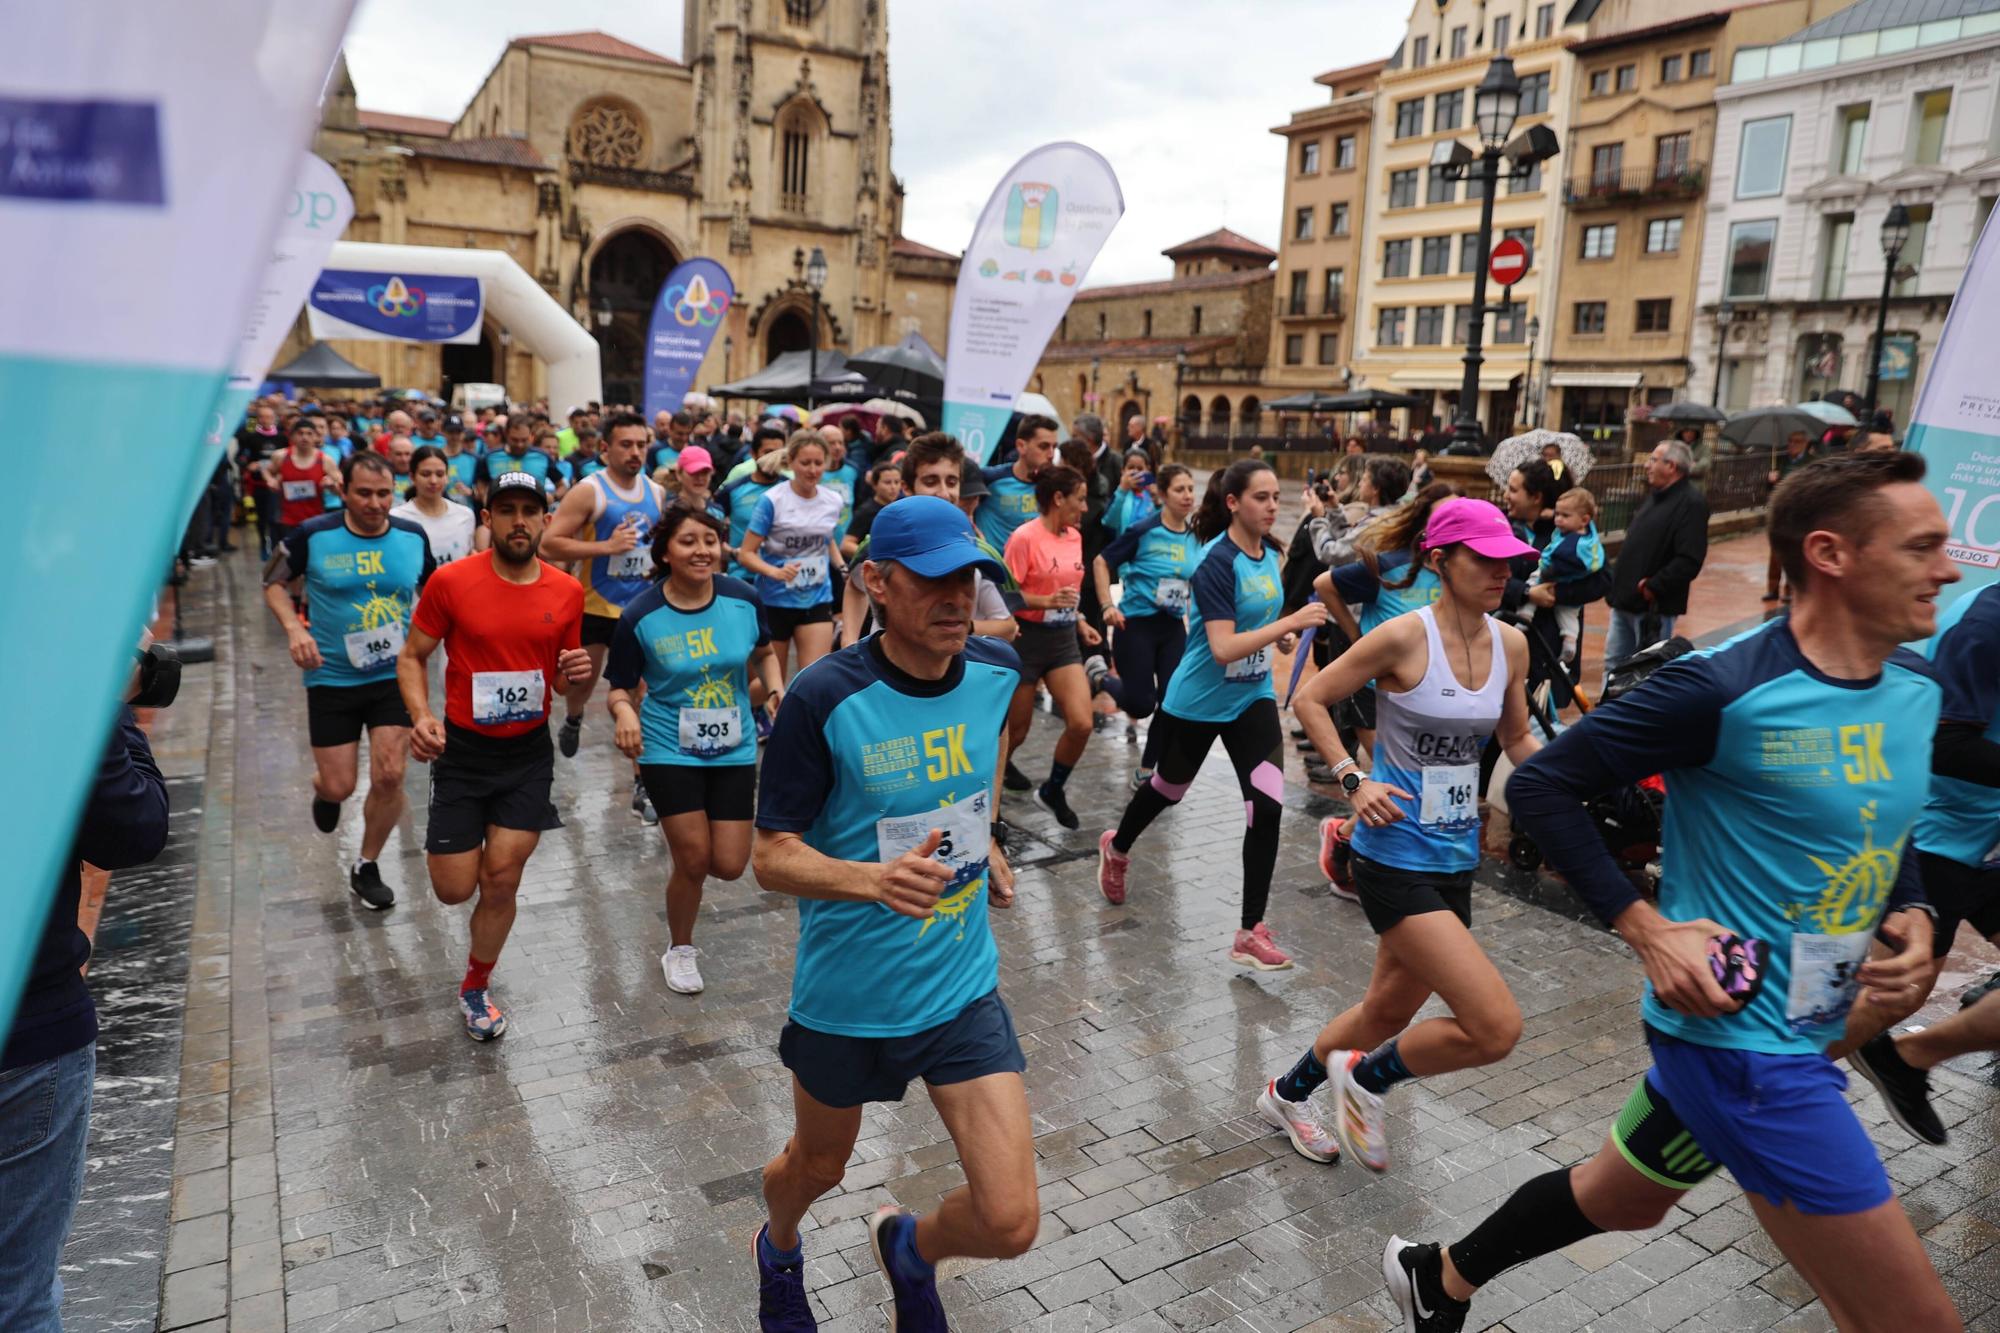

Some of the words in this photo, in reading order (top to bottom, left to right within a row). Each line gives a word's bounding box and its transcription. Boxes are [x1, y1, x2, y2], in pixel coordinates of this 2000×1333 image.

[356, 551, 385, 575] 5K
[625, 557, 643, 568] 371
[366, 638, 391, 654] 186
[686, 627, 719, 659] 5K
[496, 687, 527, 703] 162
[697, 722, 729, 738] 303
[923, 724, 974, 783] 5K
[1839, 722, 1893, 784] 5K
[1448, 784, 1472, 806] 169
